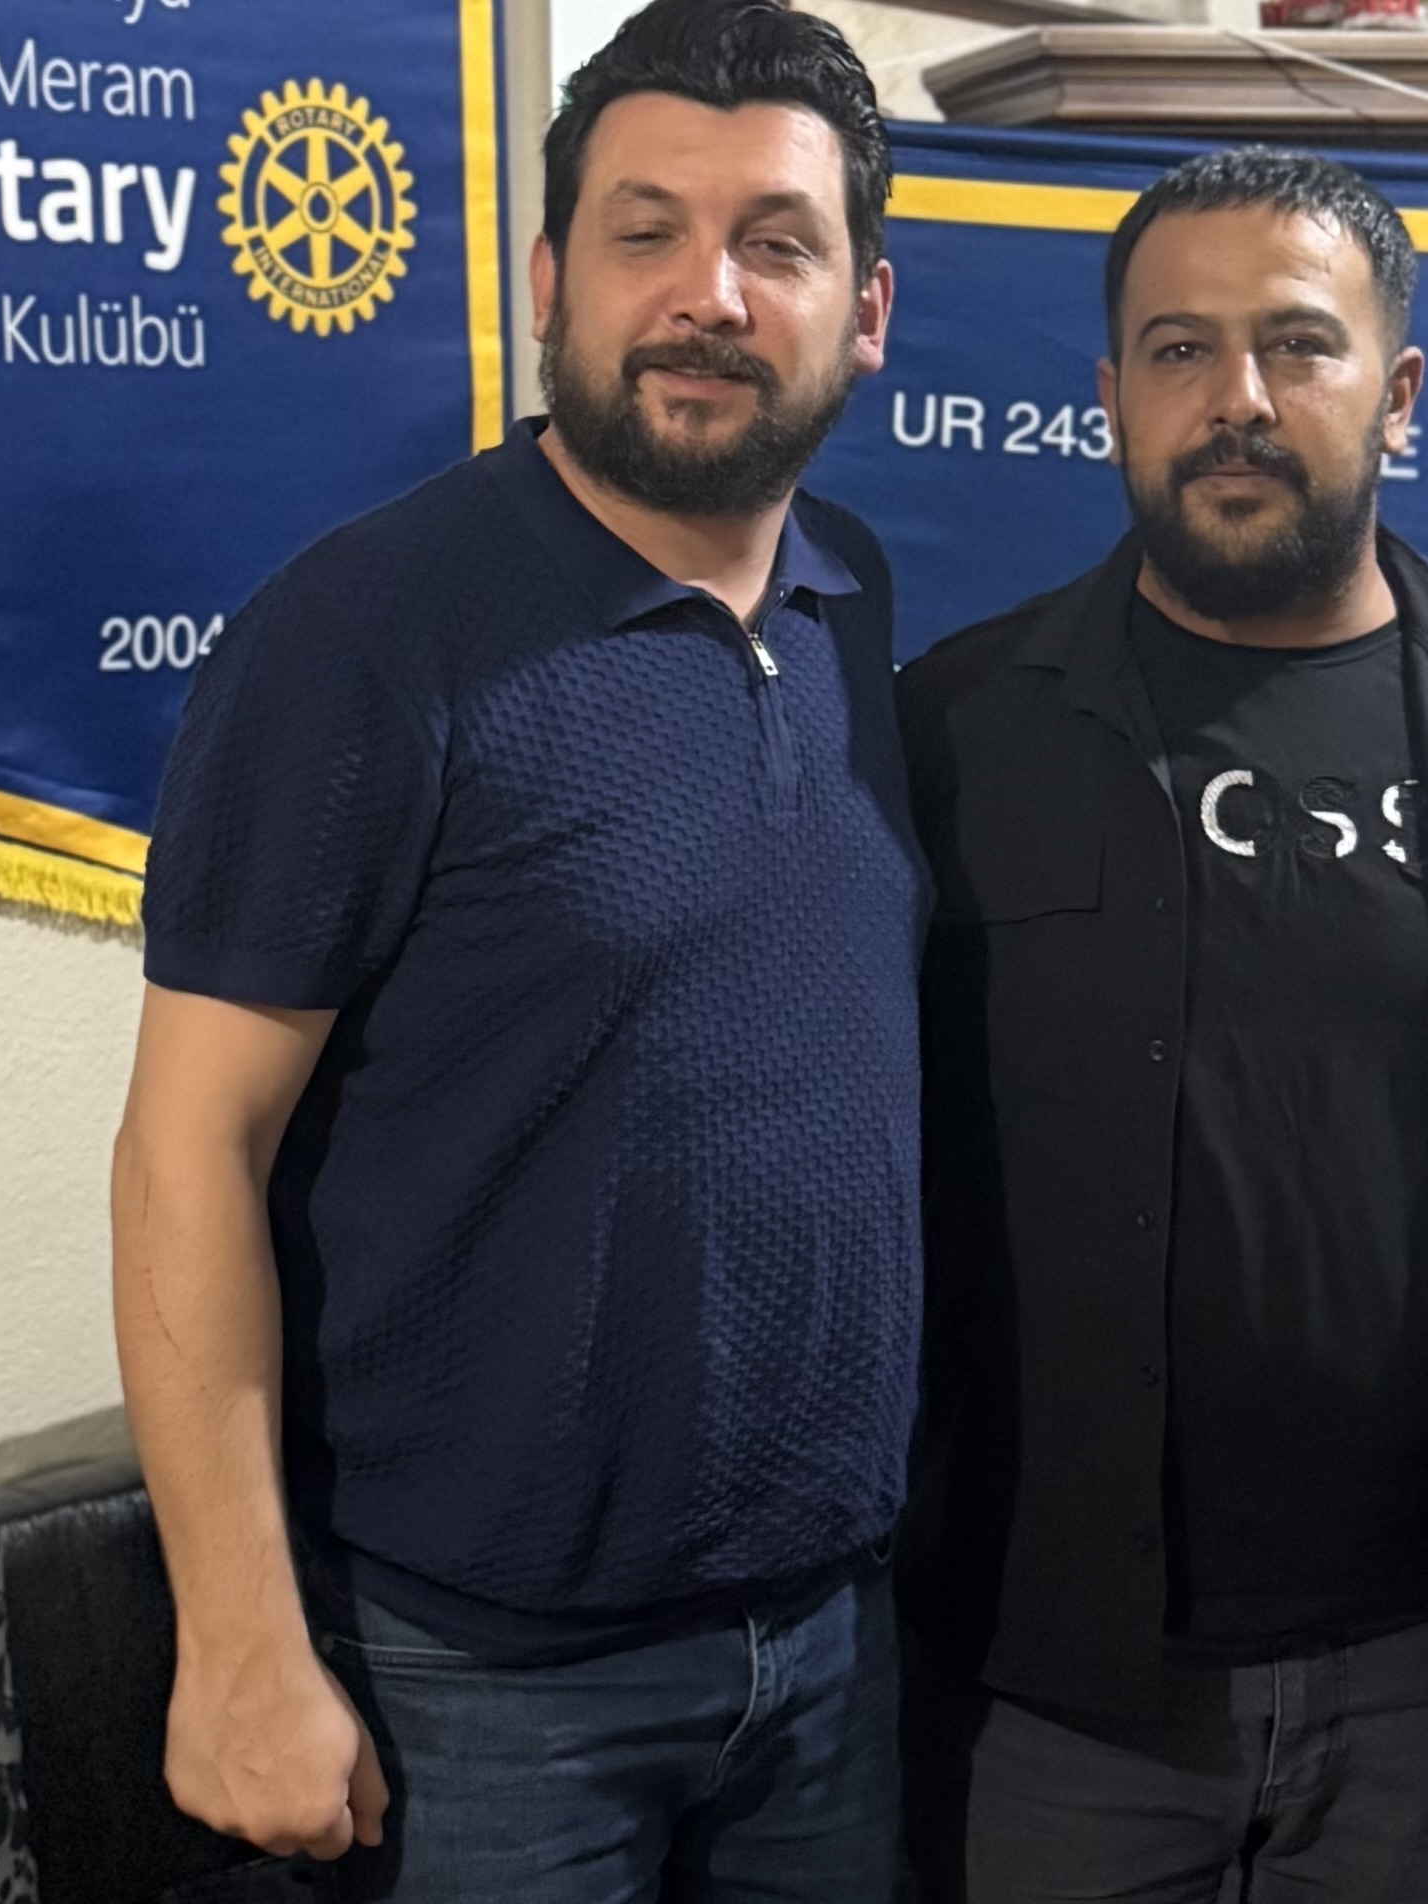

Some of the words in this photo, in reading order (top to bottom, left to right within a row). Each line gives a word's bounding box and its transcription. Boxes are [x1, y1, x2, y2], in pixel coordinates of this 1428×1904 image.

[275, 108, 357, 137] ROTARY
[255, 246, 390, 306] INTERNATIONAL
[1, 293, 206, 369] Kulübü
[892, 391, 984, 450] UR
[1003, 401, 1114, 459] 243
